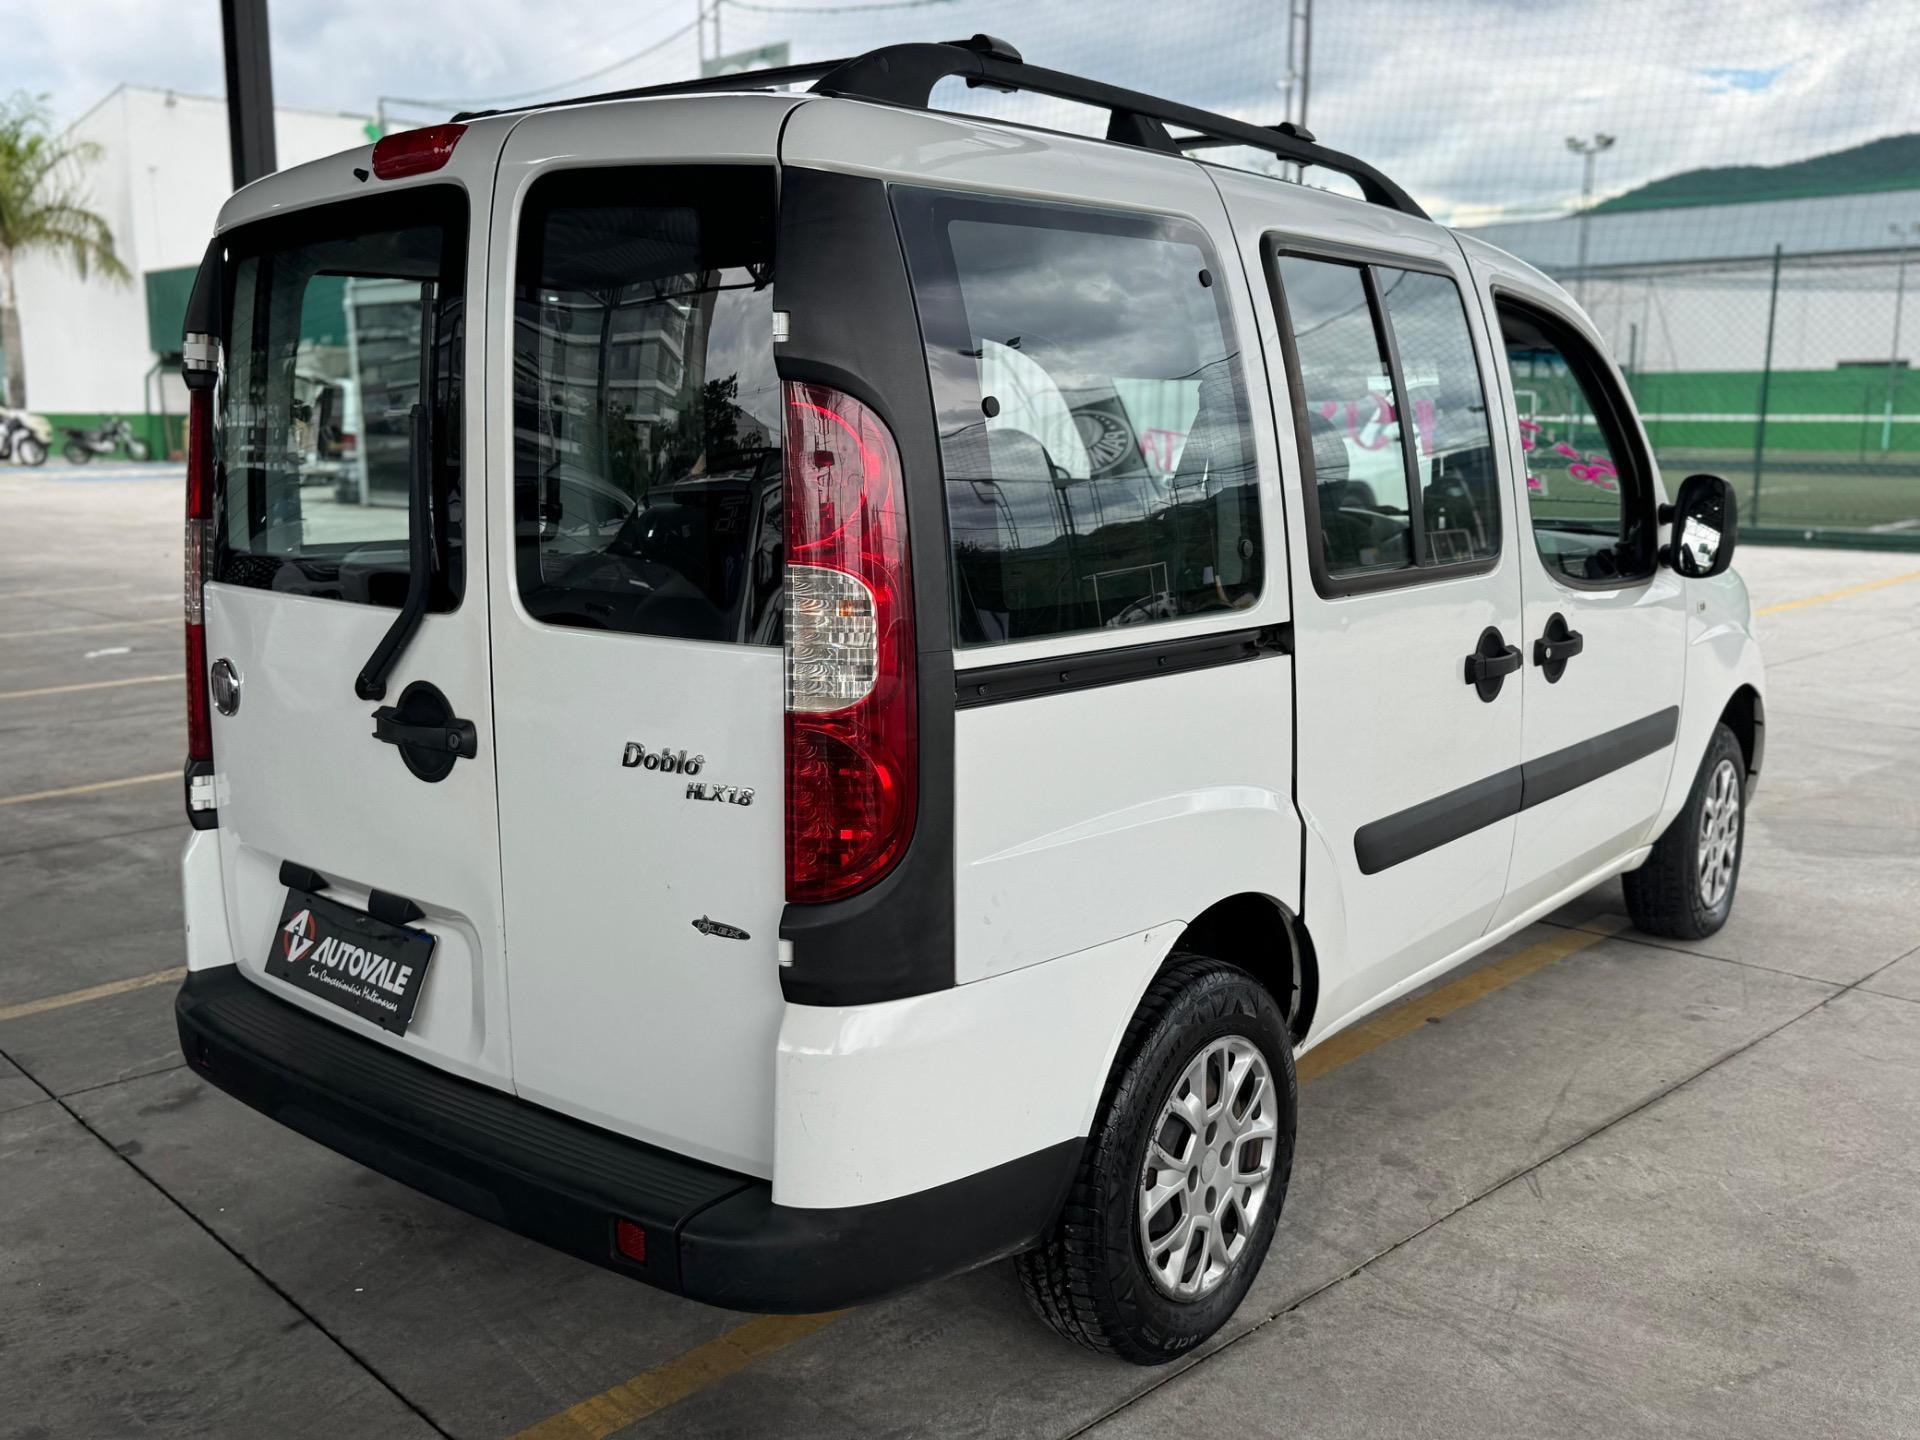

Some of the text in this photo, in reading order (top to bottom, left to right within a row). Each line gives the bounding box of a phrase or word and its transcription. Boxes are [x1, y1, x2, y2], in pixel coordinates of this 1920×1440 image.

[308, 964, 319, 978] Sua
[361, 986, 398, 1012] Multimarcas
[310, 936, 413, 995] AUTOVALE
